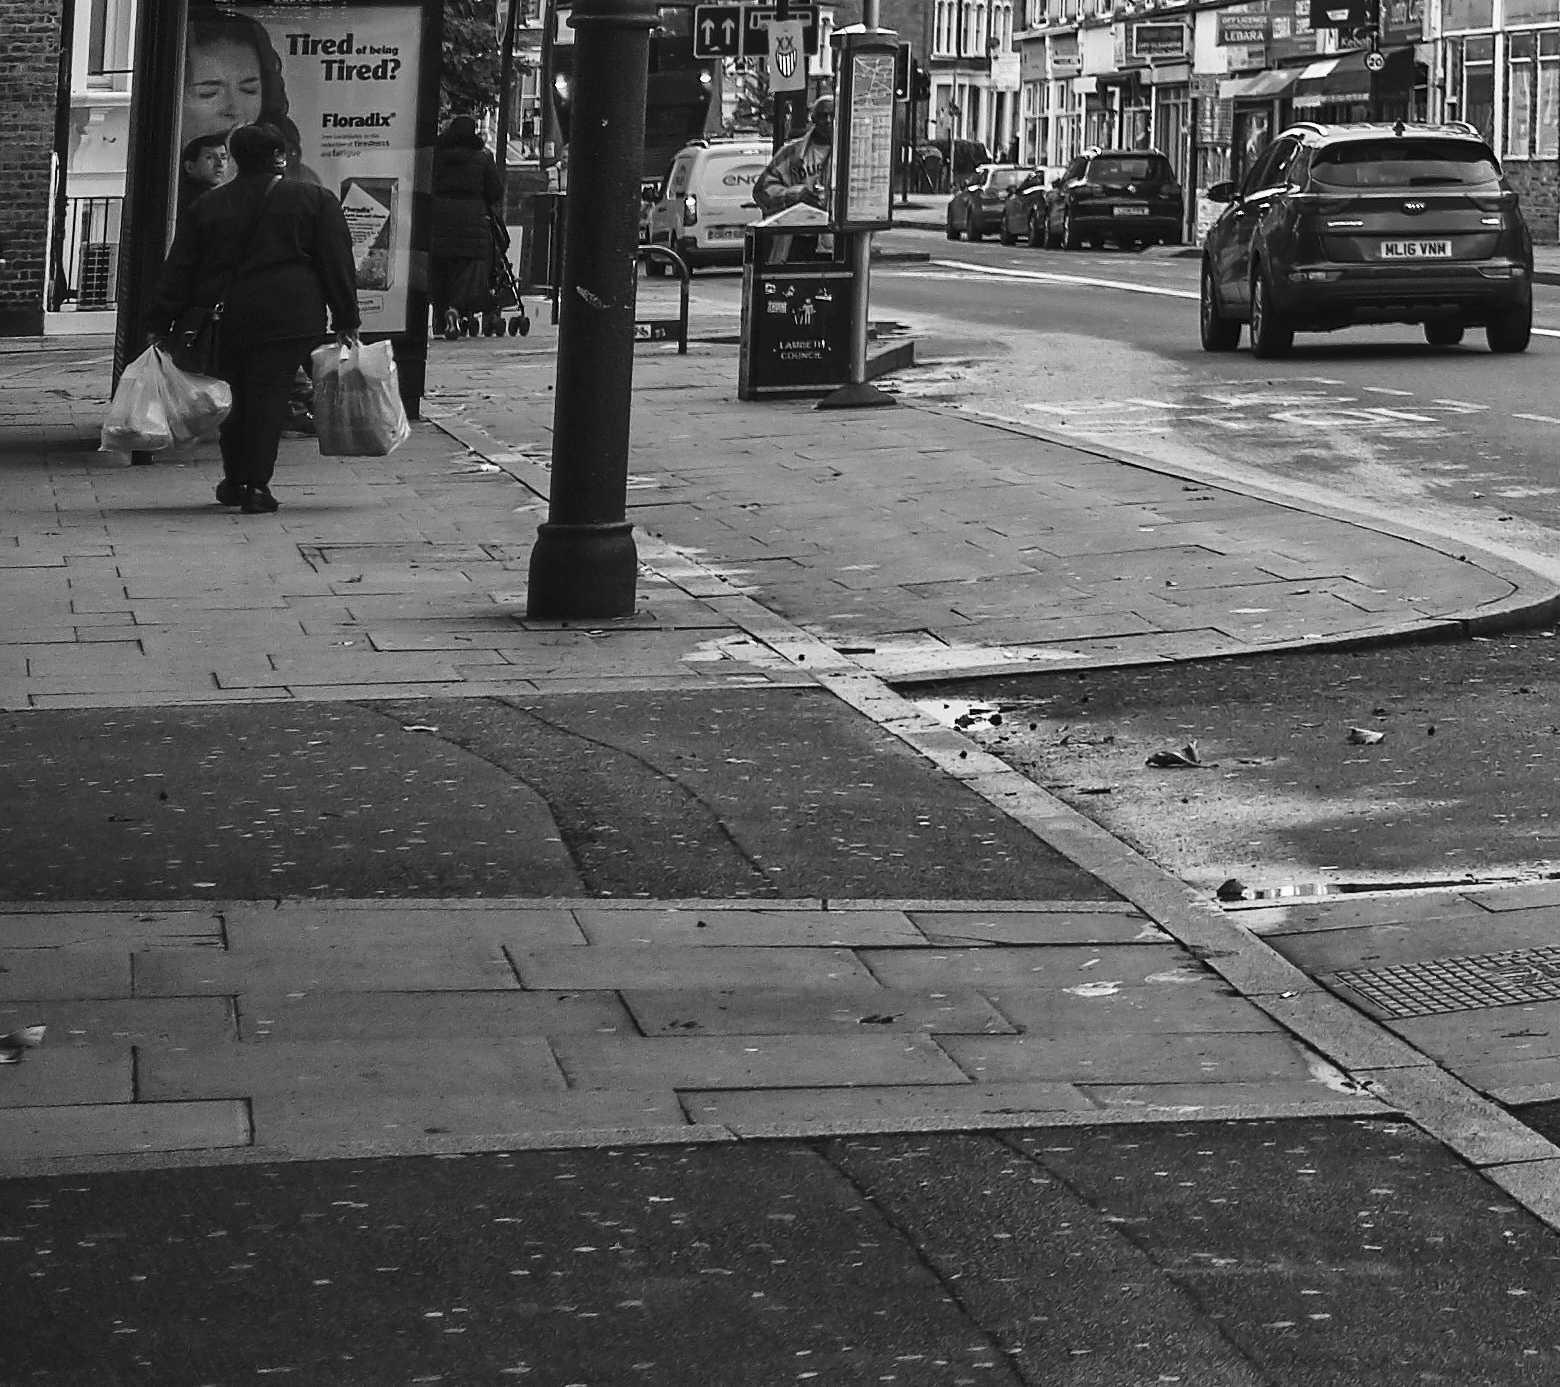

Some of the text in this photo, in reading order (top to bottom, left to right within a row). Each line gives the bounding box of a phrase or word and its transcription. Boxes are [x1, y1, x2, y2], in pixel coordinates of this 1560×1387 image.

[1224, 30, 1265, 42] LEBARA
[285, 33, 399, 56] Tired of being
[1368, 54, 1383, 67] 20
[320, 58, 401, 81] Tired?
[322, 112, 391, 128] Floradix
[1385, 243, 1416, 256] ML16
